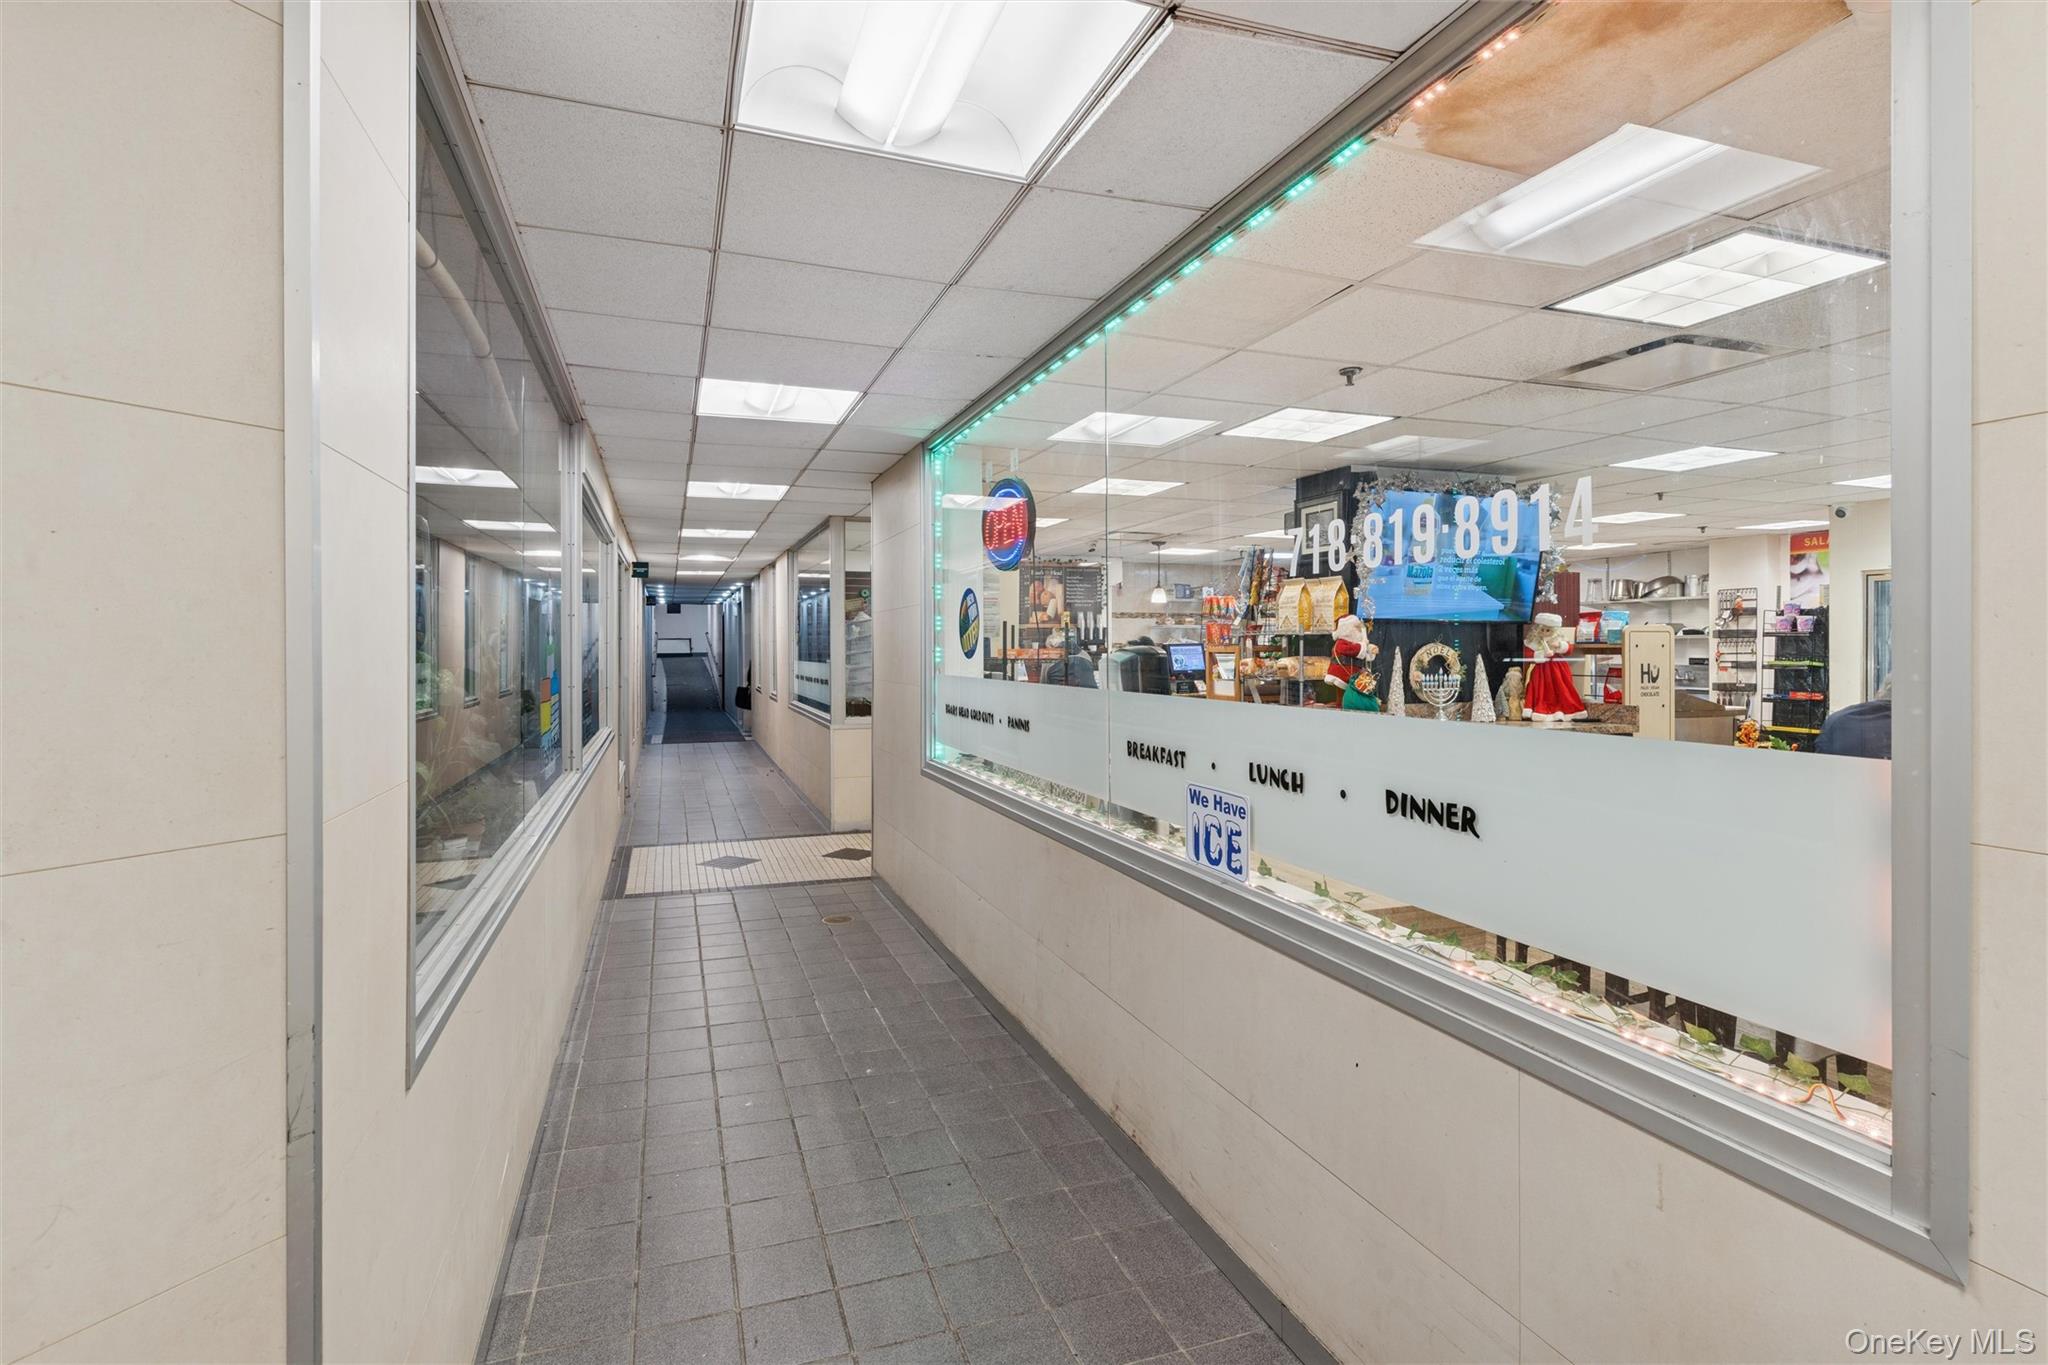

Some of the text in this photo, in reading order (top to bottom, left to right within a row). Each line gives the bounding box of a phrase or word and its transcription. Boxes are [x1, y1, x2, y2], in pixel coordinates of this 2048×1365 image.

[1426, 646, 1450, 658] NOEL
[1007, 715, 1030, 733] PANINIS
[1127, 740, 1480, 839] BREAKFAST LUNCH DINNER
[1188, 787, 1247, 820] We Have
[1192, 811, 1243, 875] ICE
